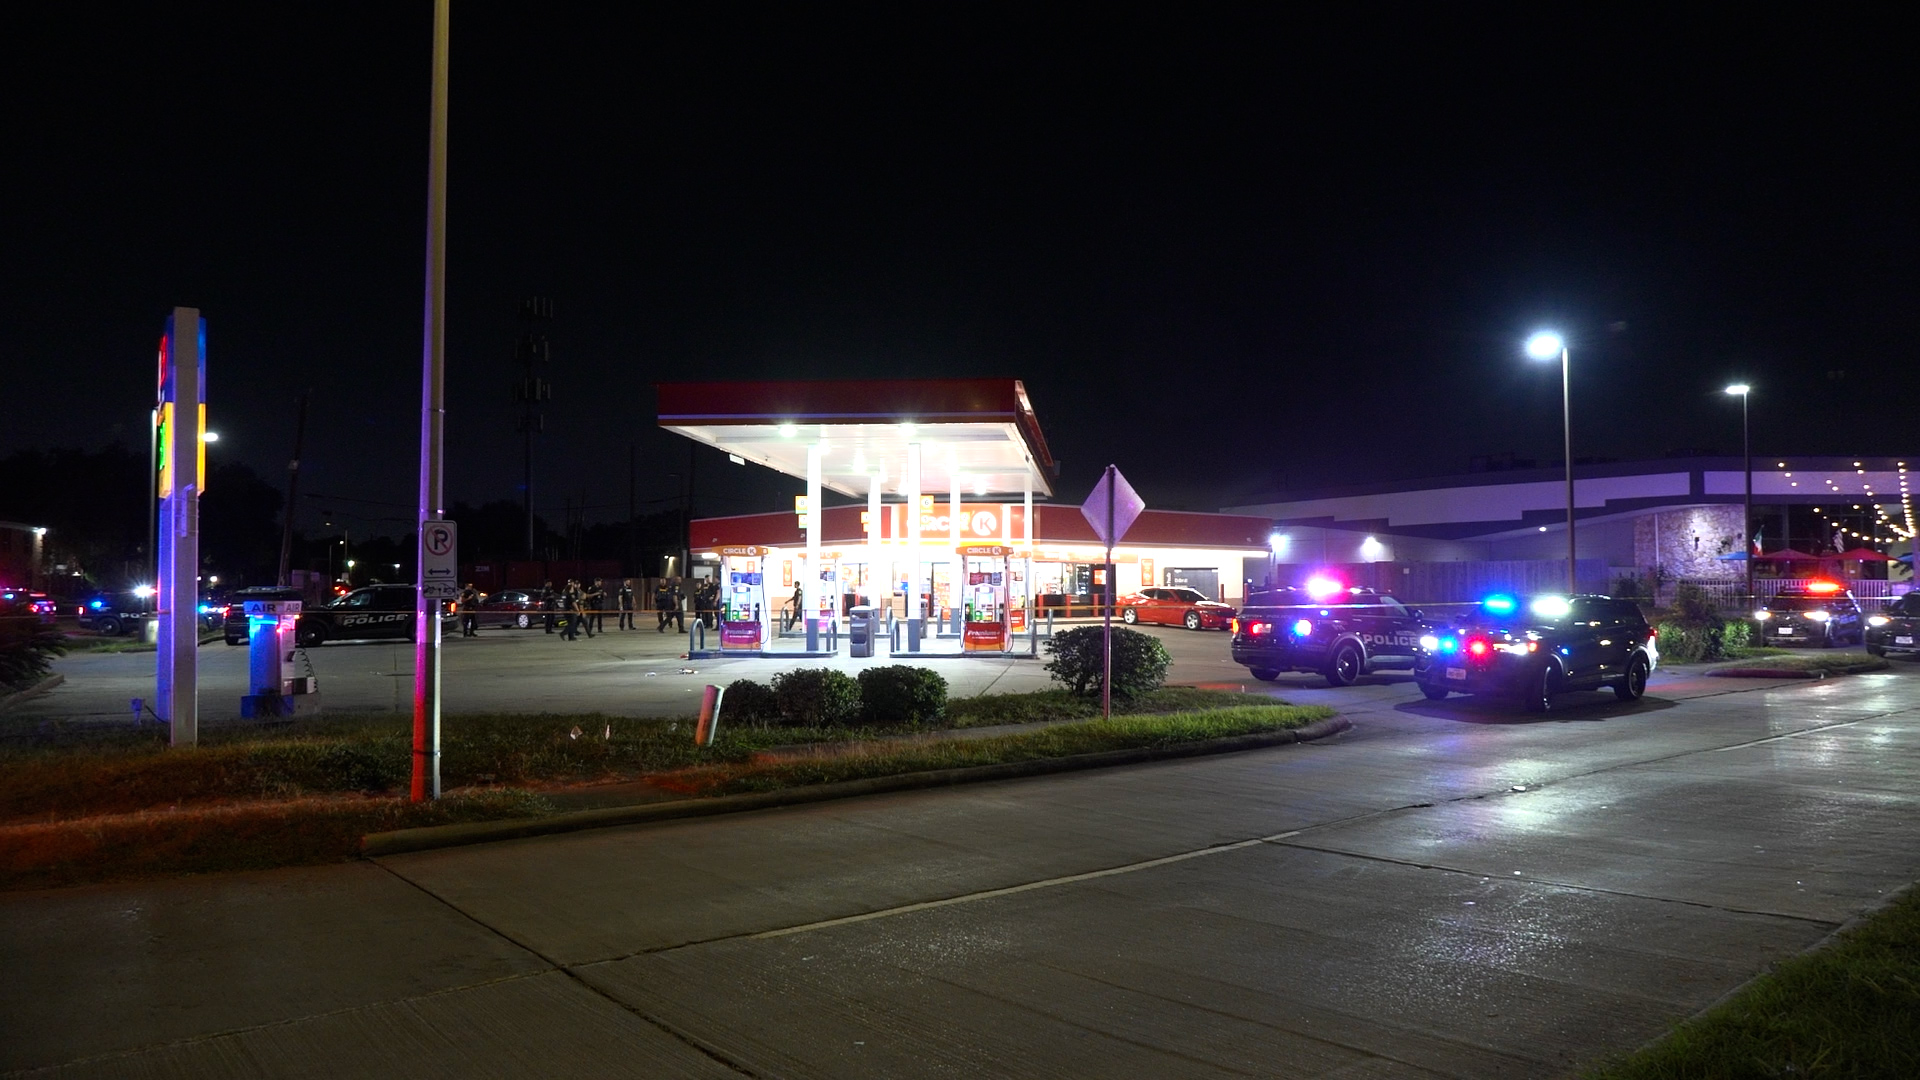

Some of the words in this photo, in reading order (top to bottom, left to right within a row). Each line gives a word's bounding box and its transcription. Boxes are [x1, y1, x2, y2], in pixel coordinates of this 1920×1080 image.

[972, 511, 997, 536] K
[434, 529, 449, 550] P
[252, 604, 276, 612] AIR
[286, 603, 299, 612] AIR
[343, 614, 407, 626] POLICE
[1362, 633, 1418, 647] POLICE
